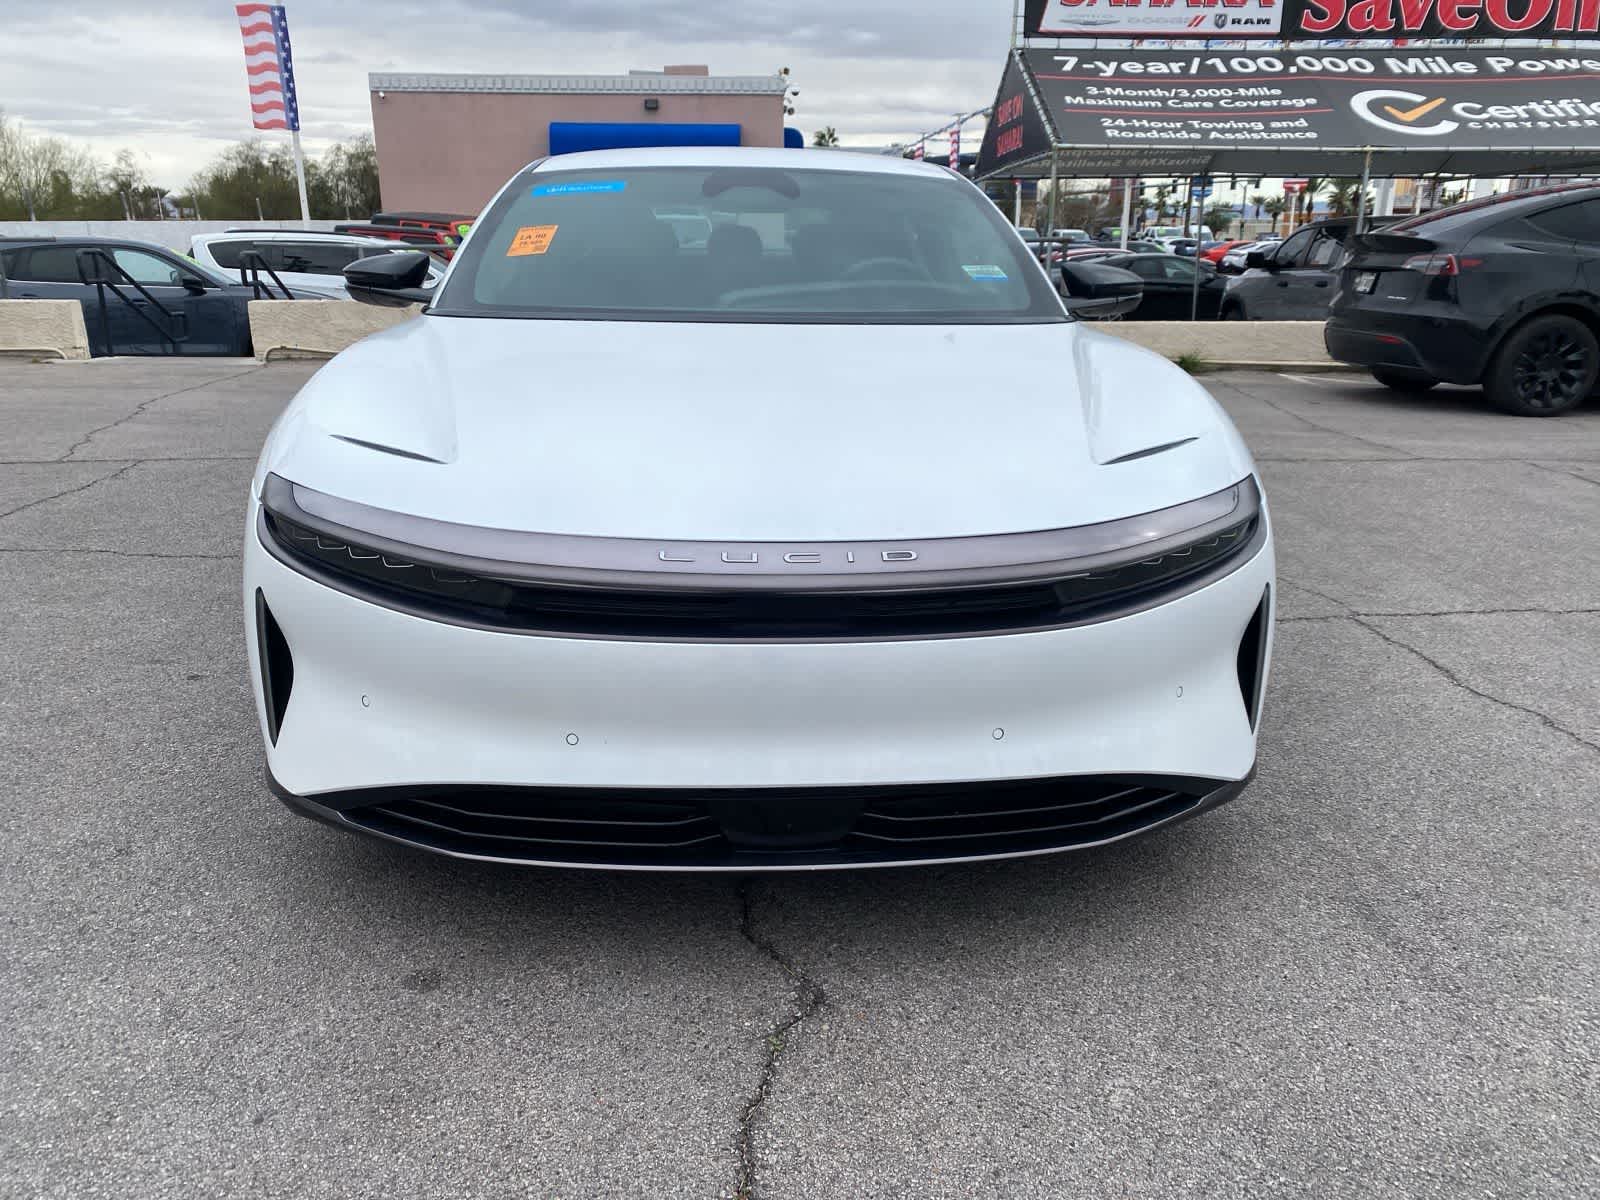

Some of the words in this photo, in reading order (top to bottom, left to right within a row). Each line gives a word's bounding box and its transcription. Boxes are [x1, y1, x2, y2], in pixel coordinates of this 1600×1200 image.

[1231, 17, 1272, 25] RAM
[1384, 56, 1478, 74] Mile
[1086, 86, 1283, 98] 3-Month/3,000-Mile
[1064, 96, 1163, 108] Maximum
[1167, 99, 1214, 109] Care
[1219, 97, 1318, 109] Coverage
[1101, 118, 1184, 129] 24-Hour
[1188, 119, 1265, 131] Towing
[1270, 117, 1309, 129] and
[1467, 120, 1600, 129] CHRYSLER
[1105, 129, 1203, 140] Roadside
[1209, 130, 1319, 140] Assistance
[658, 549, 919, 563] LUCID
